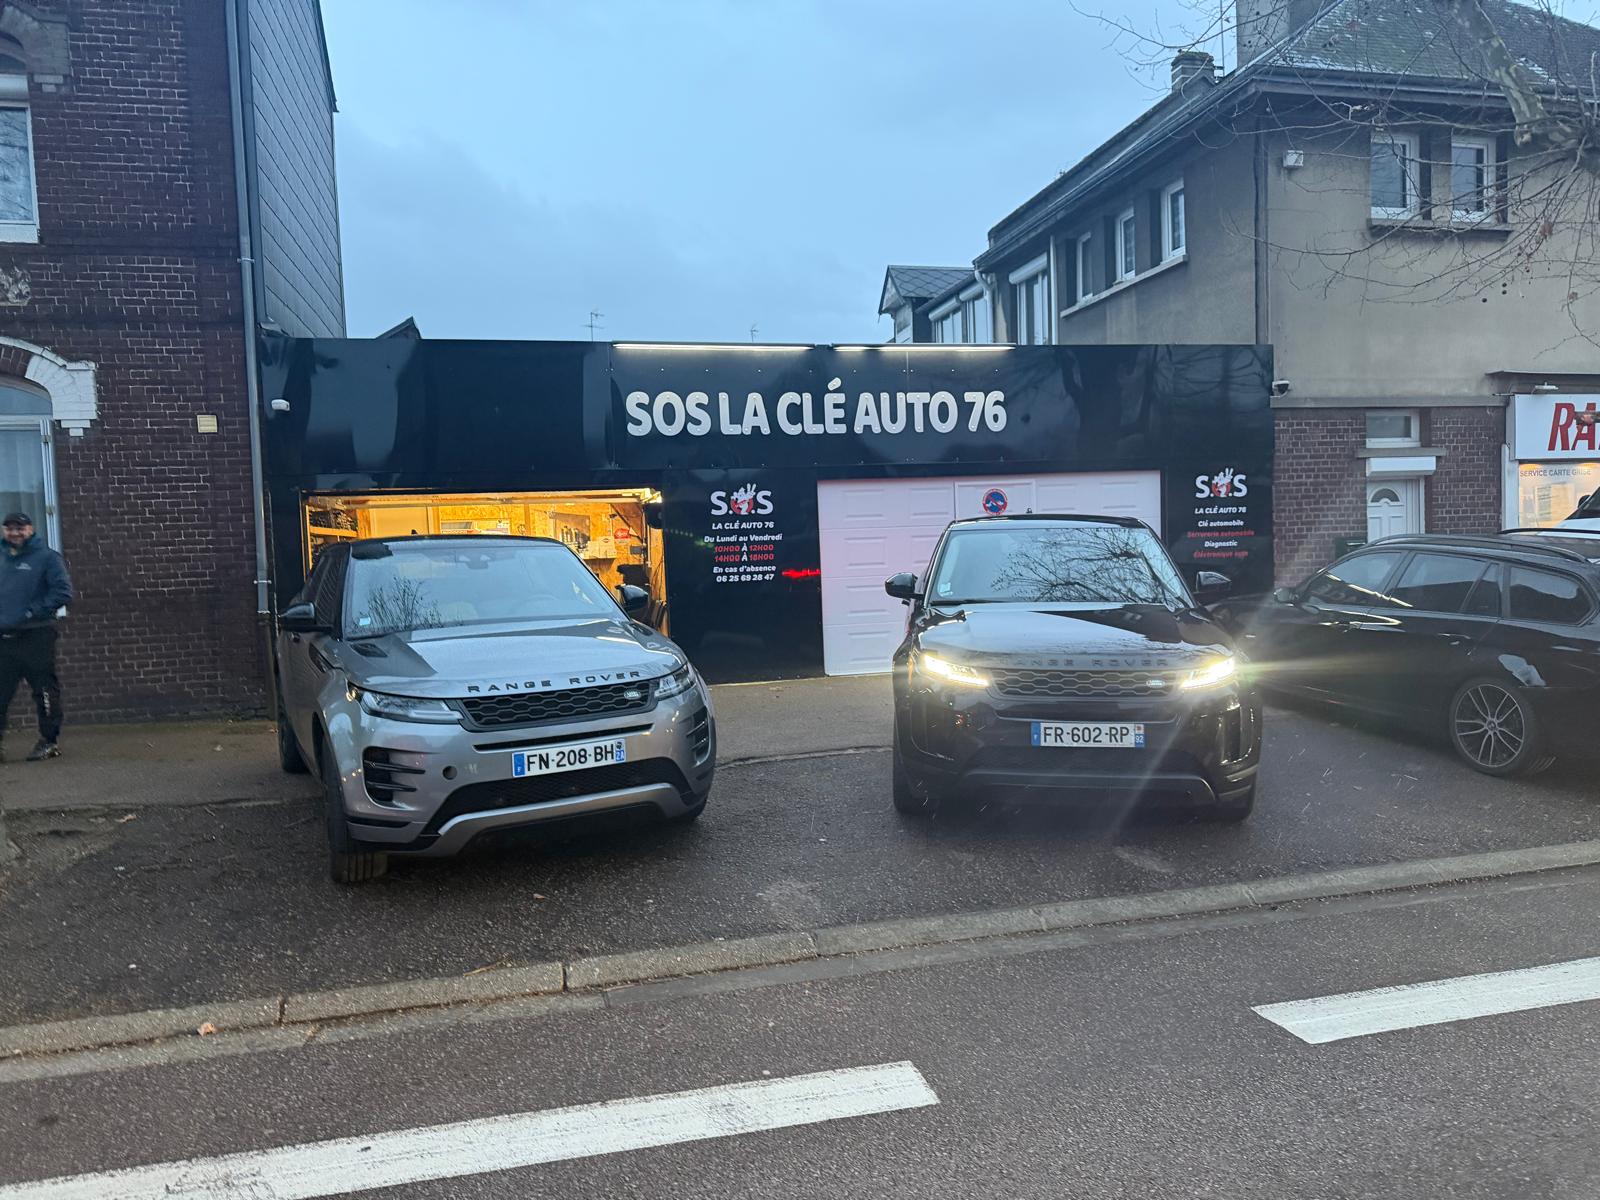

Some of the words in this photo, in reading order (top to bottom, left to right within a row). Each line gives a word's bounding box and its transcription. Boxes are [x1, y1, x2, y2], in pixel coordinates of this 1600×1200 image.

[625, 391, 711, 436] SOS
[718, 391, 771, 436] LA
[776, 377, 847, 435] CLÉ
[854, 391, 958, 434] AUTO
[963, 390, 1007, 432] 76
[1547, 402, 1600, 451] RA
[1520, 469, 1547, 477] SERVICE
[1548, 468, 1570, 476] CARTE
[1204, 505, 1218, 514] CLÉ
[711, 522, 723, 530] LA
[724, 520, 740, 529] CLÉ
[740, 521, 763, 529] AUTO
[716, 534, 738, 542] Lundi
[749, 533, 783, 541] Vendredi
[714, 545, 740, 553] 10H00
[741, 543, 748, 552] À
[1204, 540, 1238, 548] Diagnostic
[714, 554, 740, 562] 14H00
[741, 552, 748, 561] À
[713, 566, 723, 574] En
[739, 565, 776, 573] d'absence
[740, 574, 752, 582] 69
[1092, 658, 1168, 667] ROVER
[467, 679, 552, 693] RANGE
[569, 671, 641, 685] ROVER
[1043, 726, 1130, 743] FR-602-RP
[1135, 735, 1144, 743] 92
[526, 743, 615, 772] FN-208-BH
[615, 750, 625, 761] 2A
